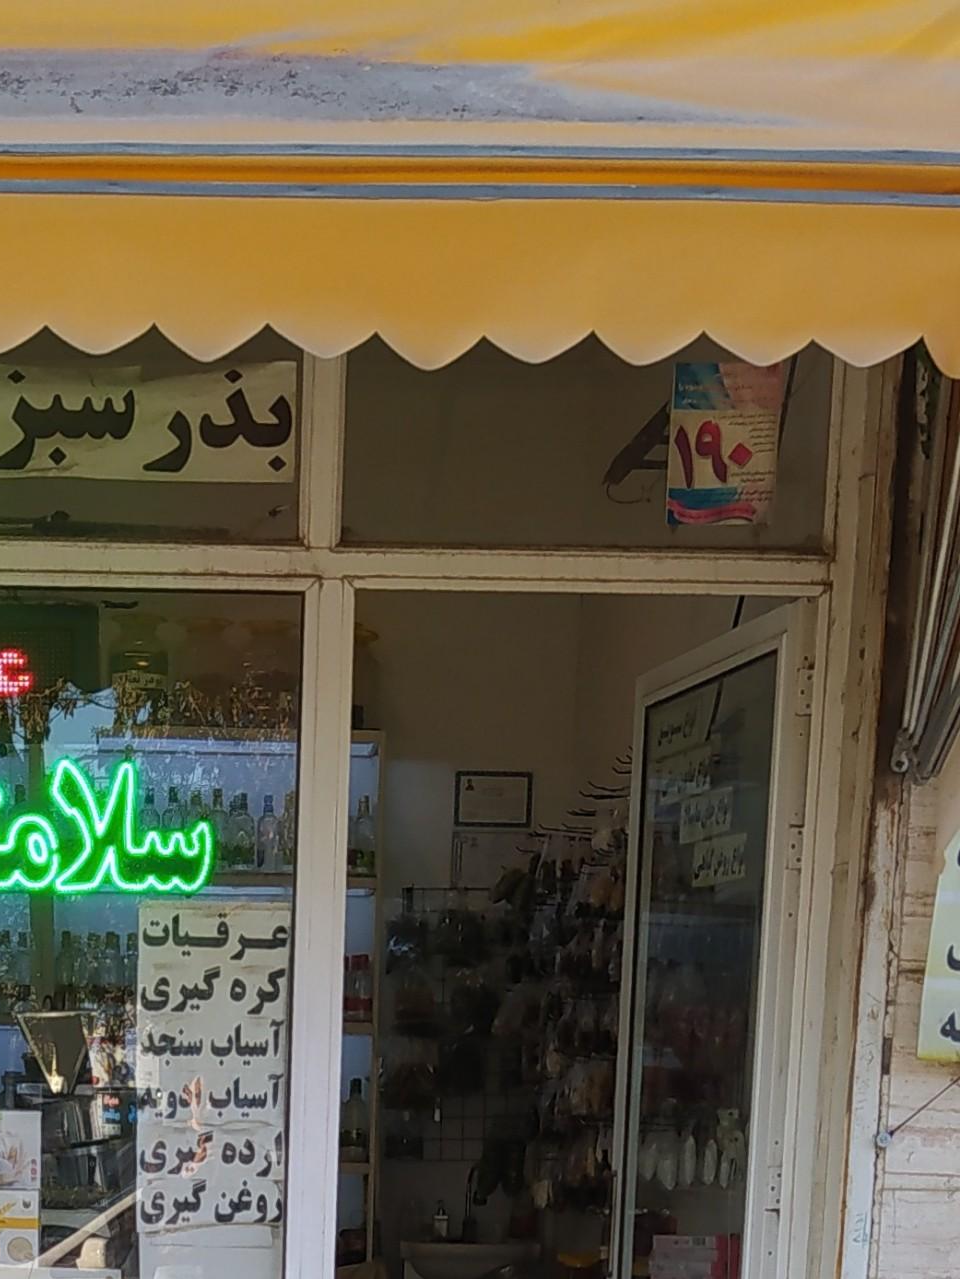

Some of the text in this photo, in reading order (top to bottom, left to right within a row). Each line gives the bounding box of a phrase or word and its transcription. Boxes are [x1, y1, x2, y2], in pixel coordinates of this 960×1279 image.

[142, 368, 293, 473] بذر
[673, 418, 754, 490] ۱۹۰
[142, 911, 290, 960] عرقیات
[140, 965, 286, 1015] کره گیری
[141, 1018, 285, 1067] آسیاب سنجد
[139, 1077, 203, 1119] ادویه
[208, 1072, 285, 1117] آسیاب
[140, 1130, 283, 1178] ارده گیری
[140, 1179, 283, 1225] روغن گیری
